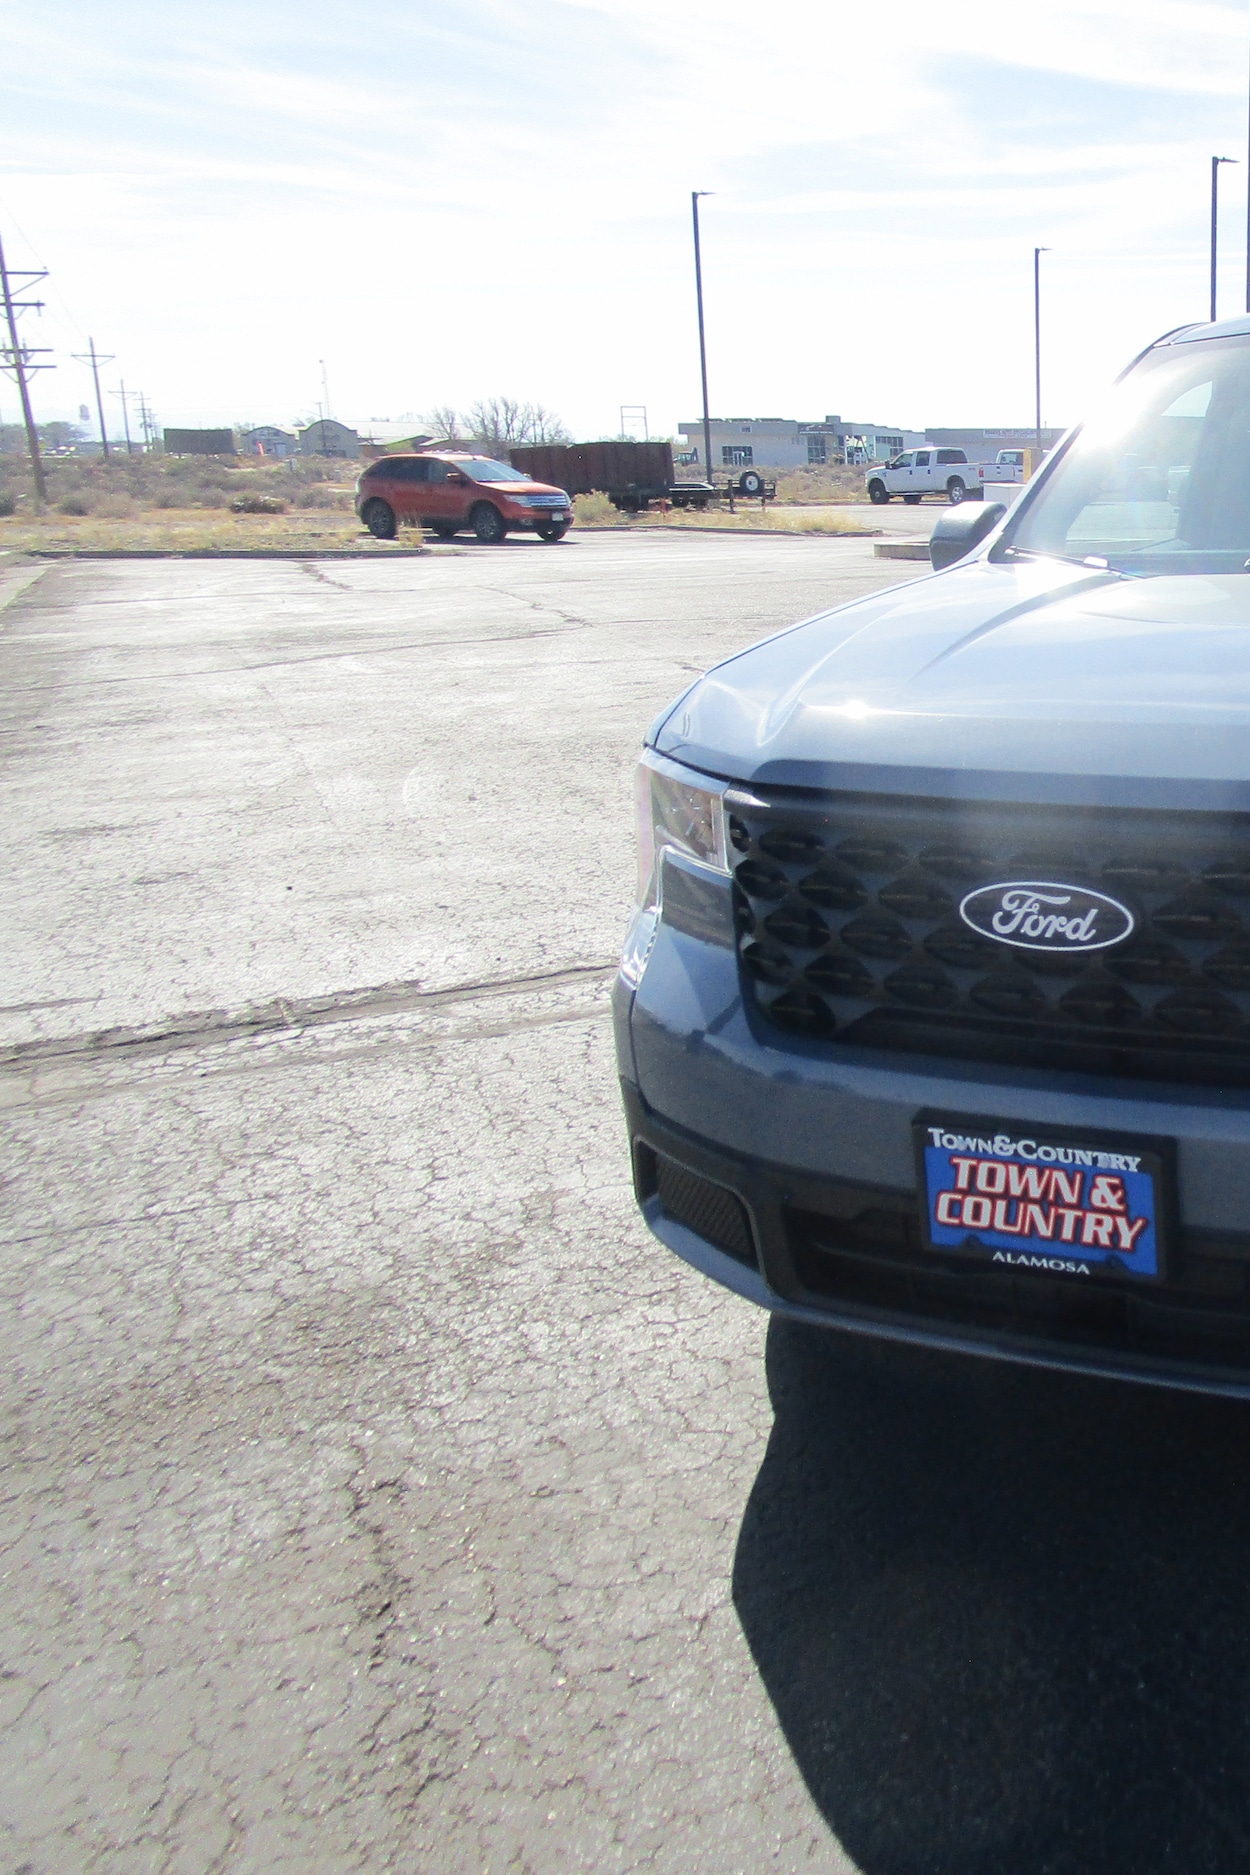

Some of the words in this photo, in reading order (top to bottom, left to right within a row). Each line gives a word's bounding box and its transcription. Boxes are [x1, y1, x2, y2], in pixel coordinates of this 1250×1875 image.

[992, 890, 1098, 941] Ford
[951, 1157, 1084, 1204] TOWN
[1089, 1174, 1126, 1211] &
[936, 1191, 1147, 1251] COUNTRY
[992, 1251, 1091, 1276] ALAMOSA
